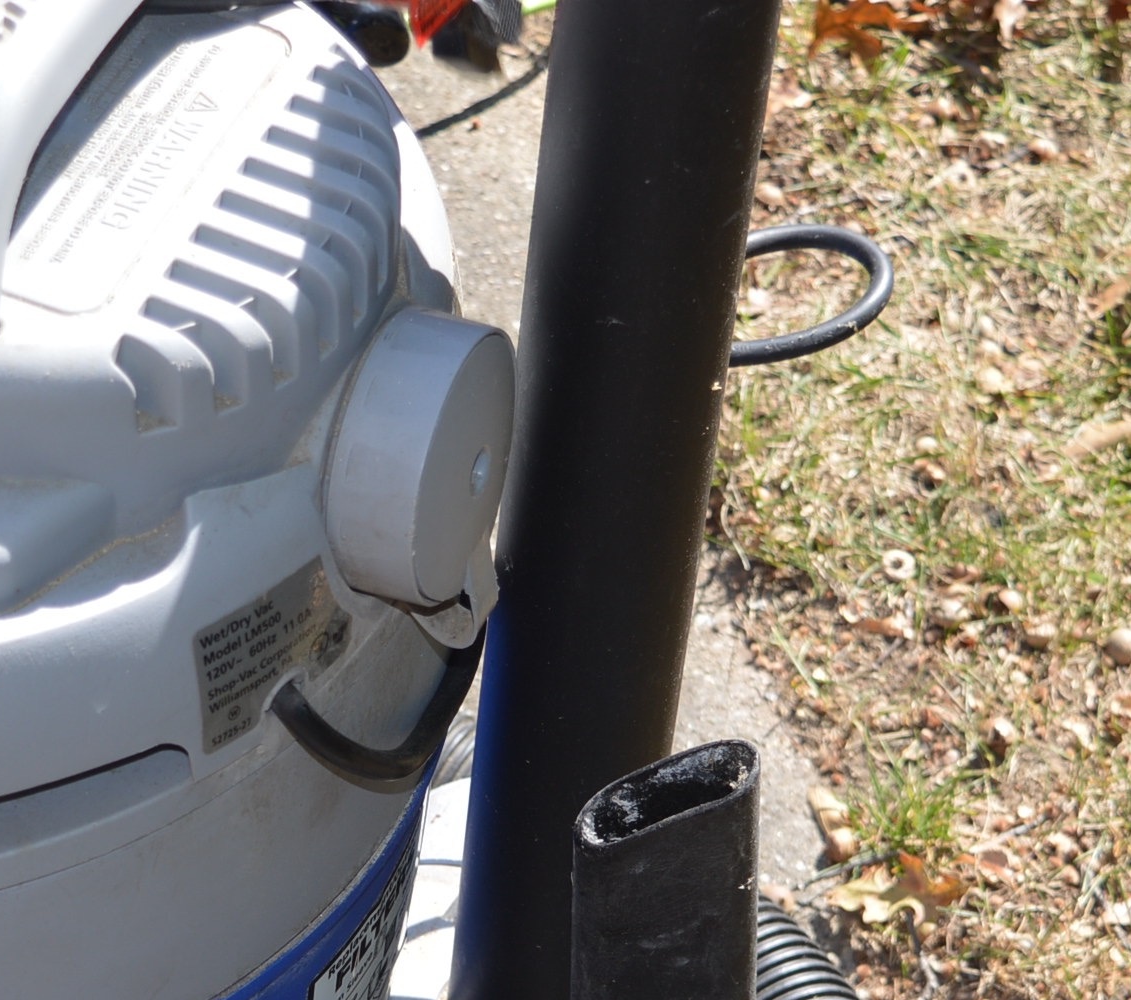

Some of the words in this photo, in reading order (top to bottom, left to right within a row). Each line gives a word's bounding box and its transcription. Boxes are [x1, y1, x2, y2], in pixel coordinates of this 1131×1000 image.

[99, 117, 203, 233] WARNING
[200, 615, 252, 649] Wet/Dry
[254, 600, 274, 617] Vac
[203, 640, 242, 666] Model
[245, 612, 282, 644] LM500
[249, 634, 277, 657] 60Hz
[284, 608, 312, 635] 11.0A
[208, 666, 257, 700] Shop-Vac
[260, 624, 318, 671] Corporation
